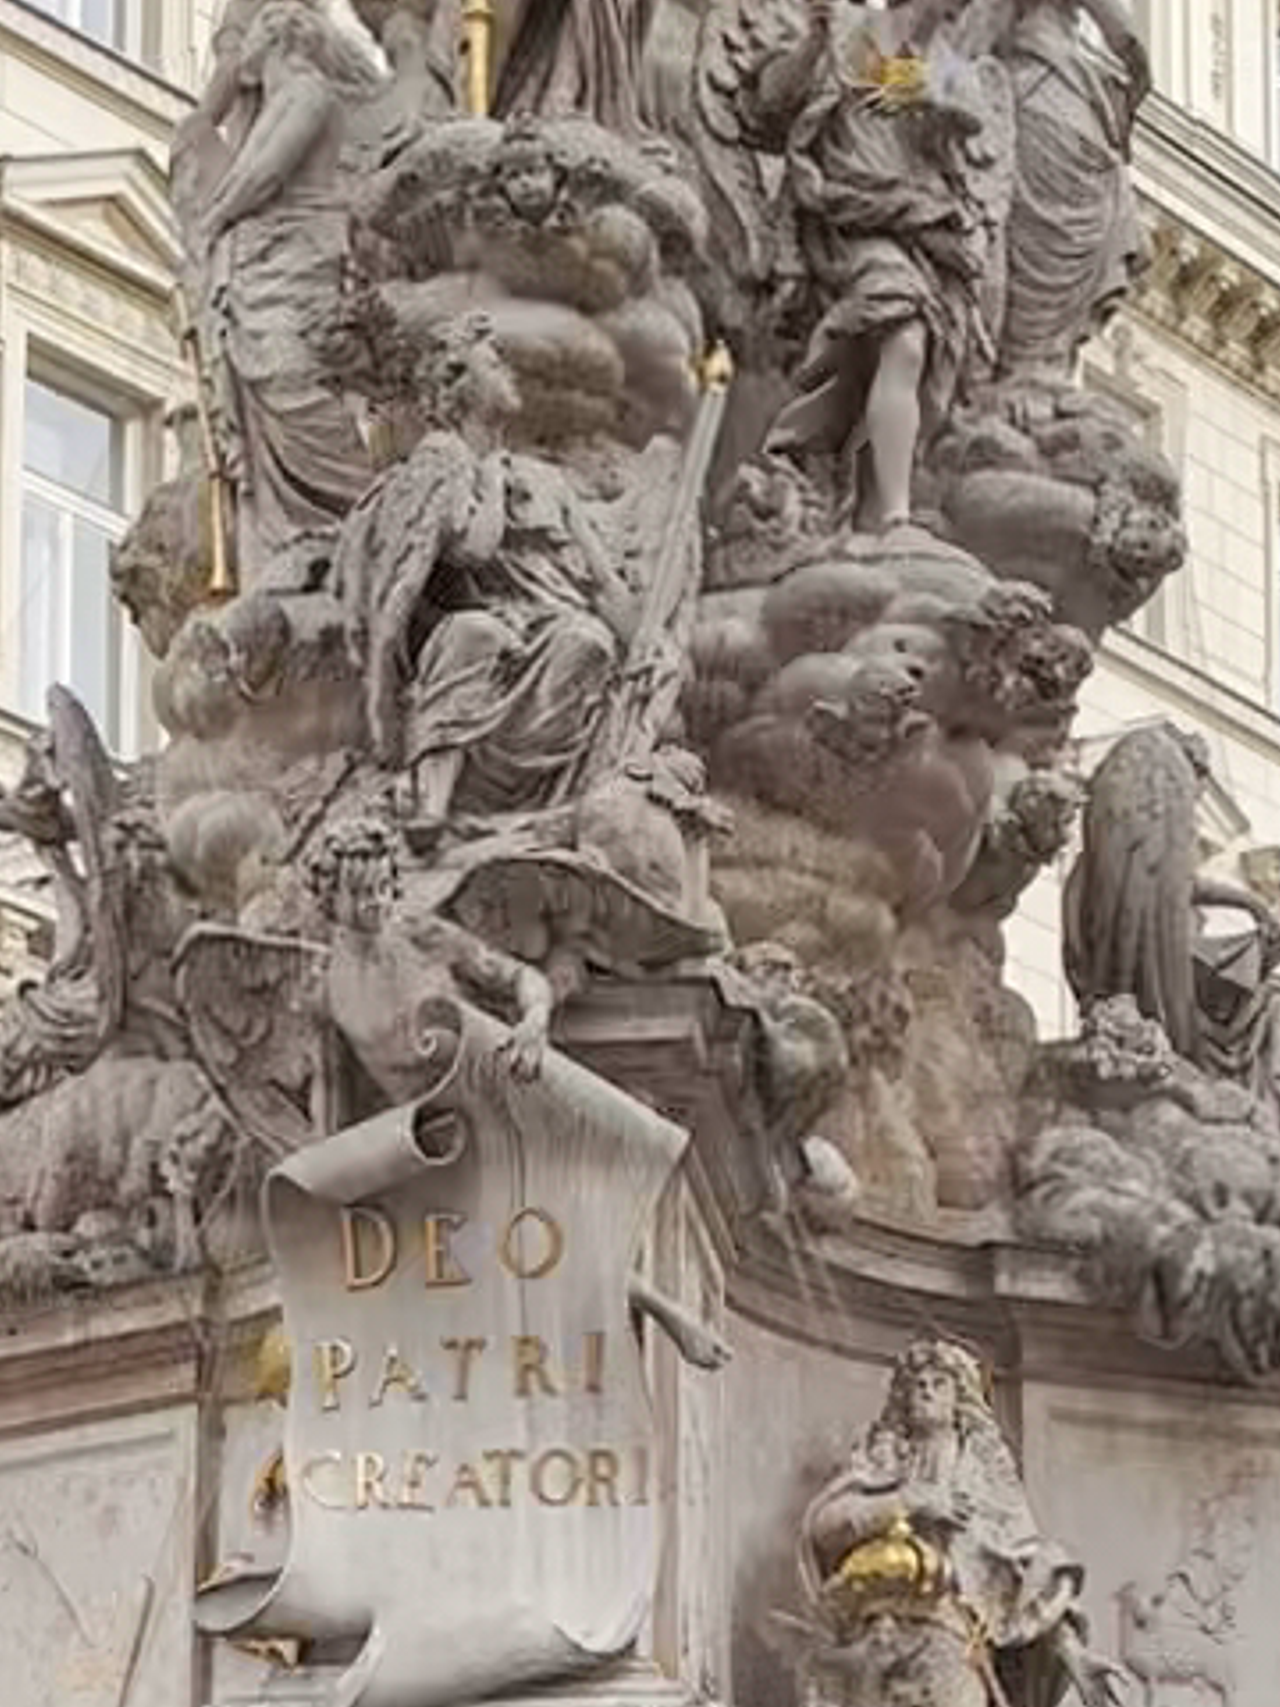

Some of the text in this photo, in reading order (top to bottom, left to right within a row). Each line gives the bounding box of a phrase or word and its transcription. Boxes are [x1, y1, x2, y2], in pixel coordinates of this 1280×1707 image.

[340, 1204, 563, 1289] DEO
[317, 1332, 607, 1410] PATRI
[301, 1446, 651, 1513] CREATORI
